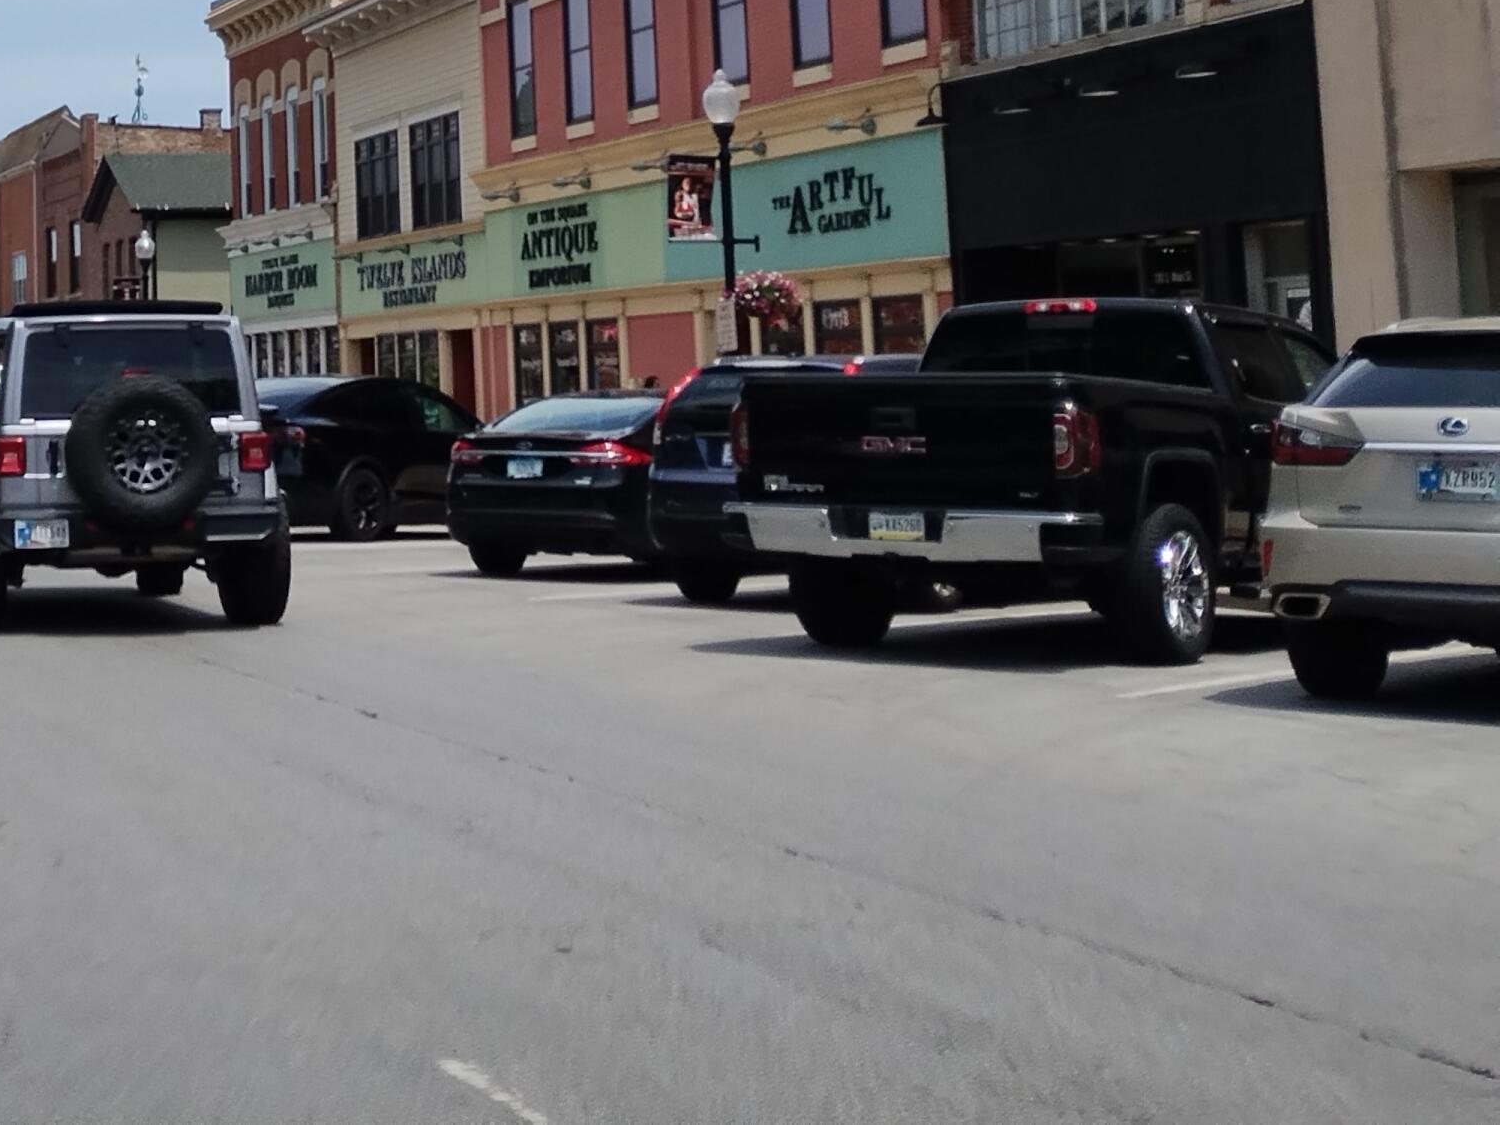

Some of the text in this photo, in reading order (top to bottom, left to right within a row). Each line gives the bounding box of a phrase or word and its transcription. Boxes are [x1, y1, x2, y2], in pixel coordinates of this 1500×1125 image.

[557, 202, 589, 222] SQUARE
[787, 166, 891, 235] ARTFUL
[818, 207, 871, 234] GARDEN
[521, 220, 598, 262] ANTIQUE
[245, 263, 317, 297] HARBOR ROOM
[357, 250, 467, 291] TWELVE ISLANDS
[528, 262, 593, 289] EMPORIUM
[861, 436, 926, 453] GMC
